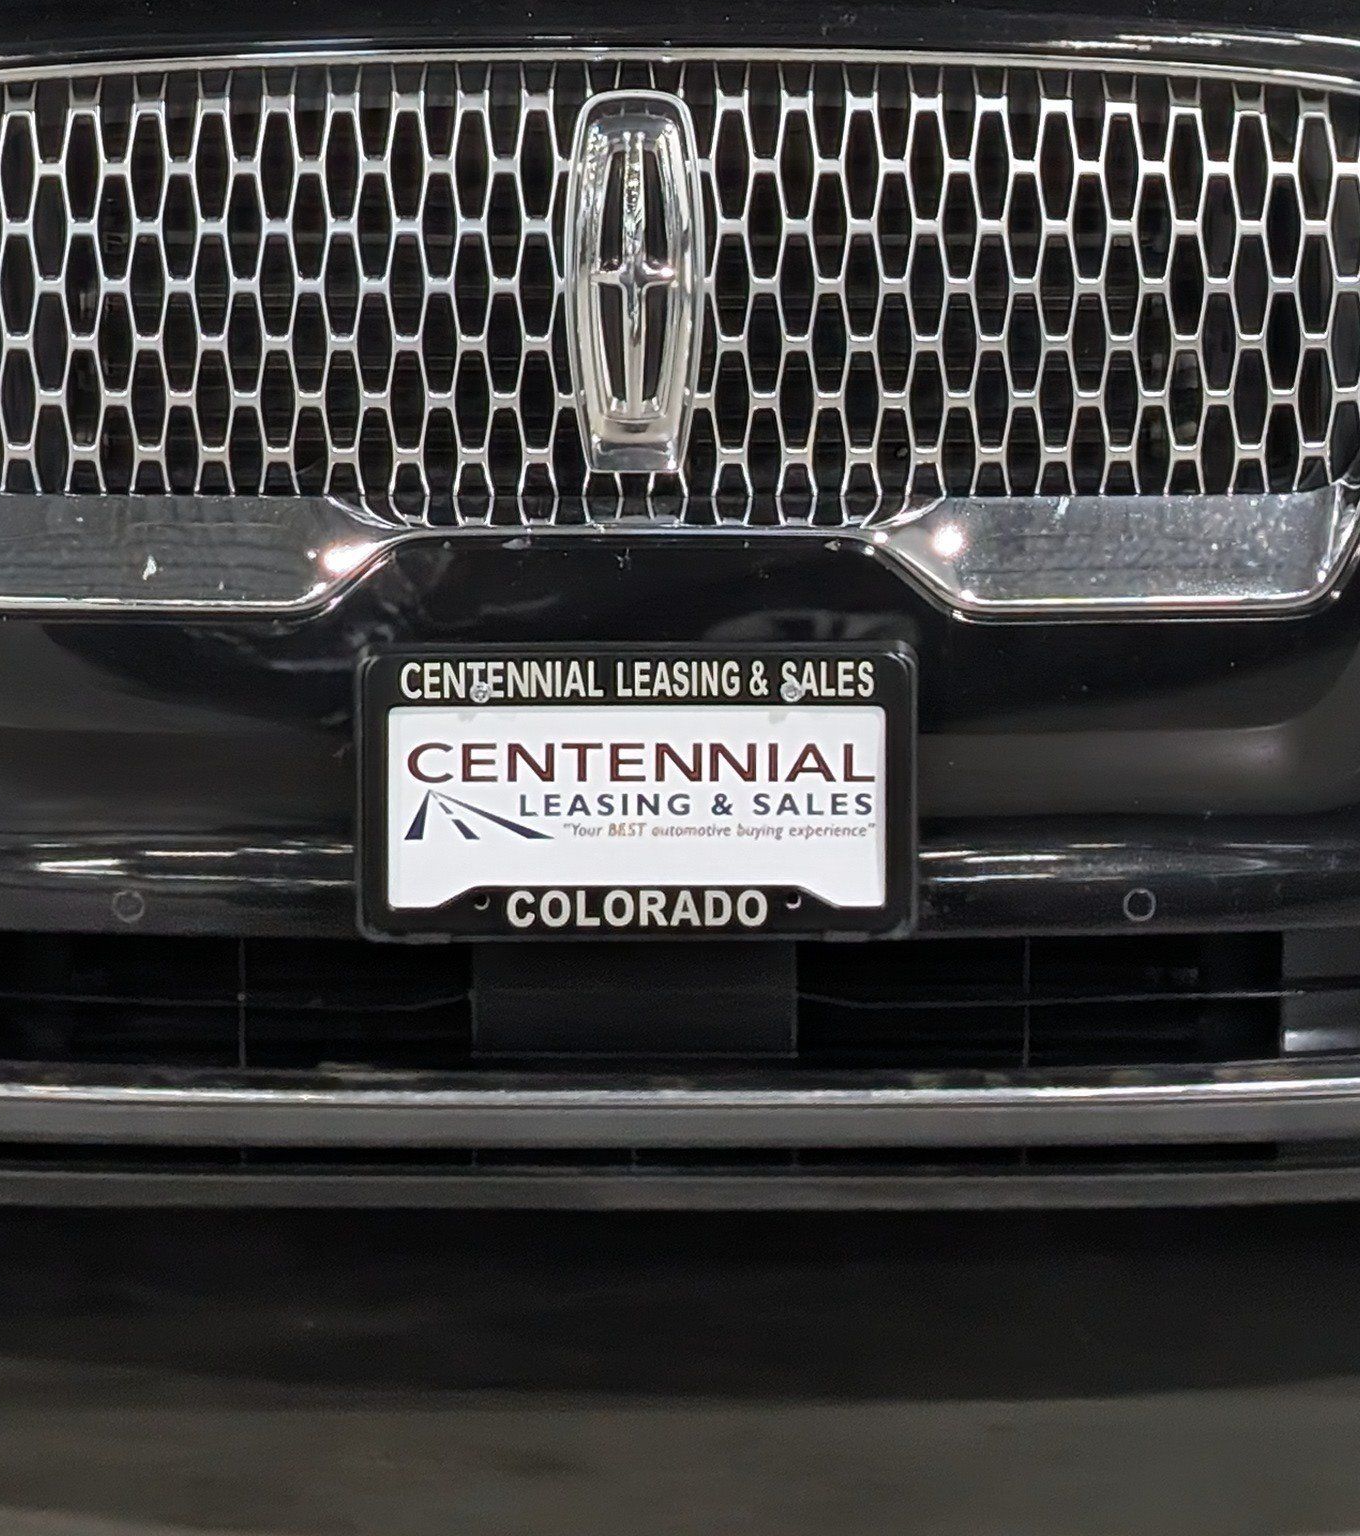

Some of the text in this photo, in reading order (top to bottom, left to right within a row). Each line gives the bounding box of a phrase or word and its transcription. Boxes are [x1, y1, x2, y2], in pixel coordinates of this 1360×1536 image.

[400, 659, 875, 700] CENTENNIAL LEASING & SALES
[406, 742, 876, 783] CENTENNIAL
[519, 792, 873, 817] LEASING & SALES
[562, 822, 876, 840] "Your BEST automotive buying experience"
[506, 889, 769, 928] COLORADO
